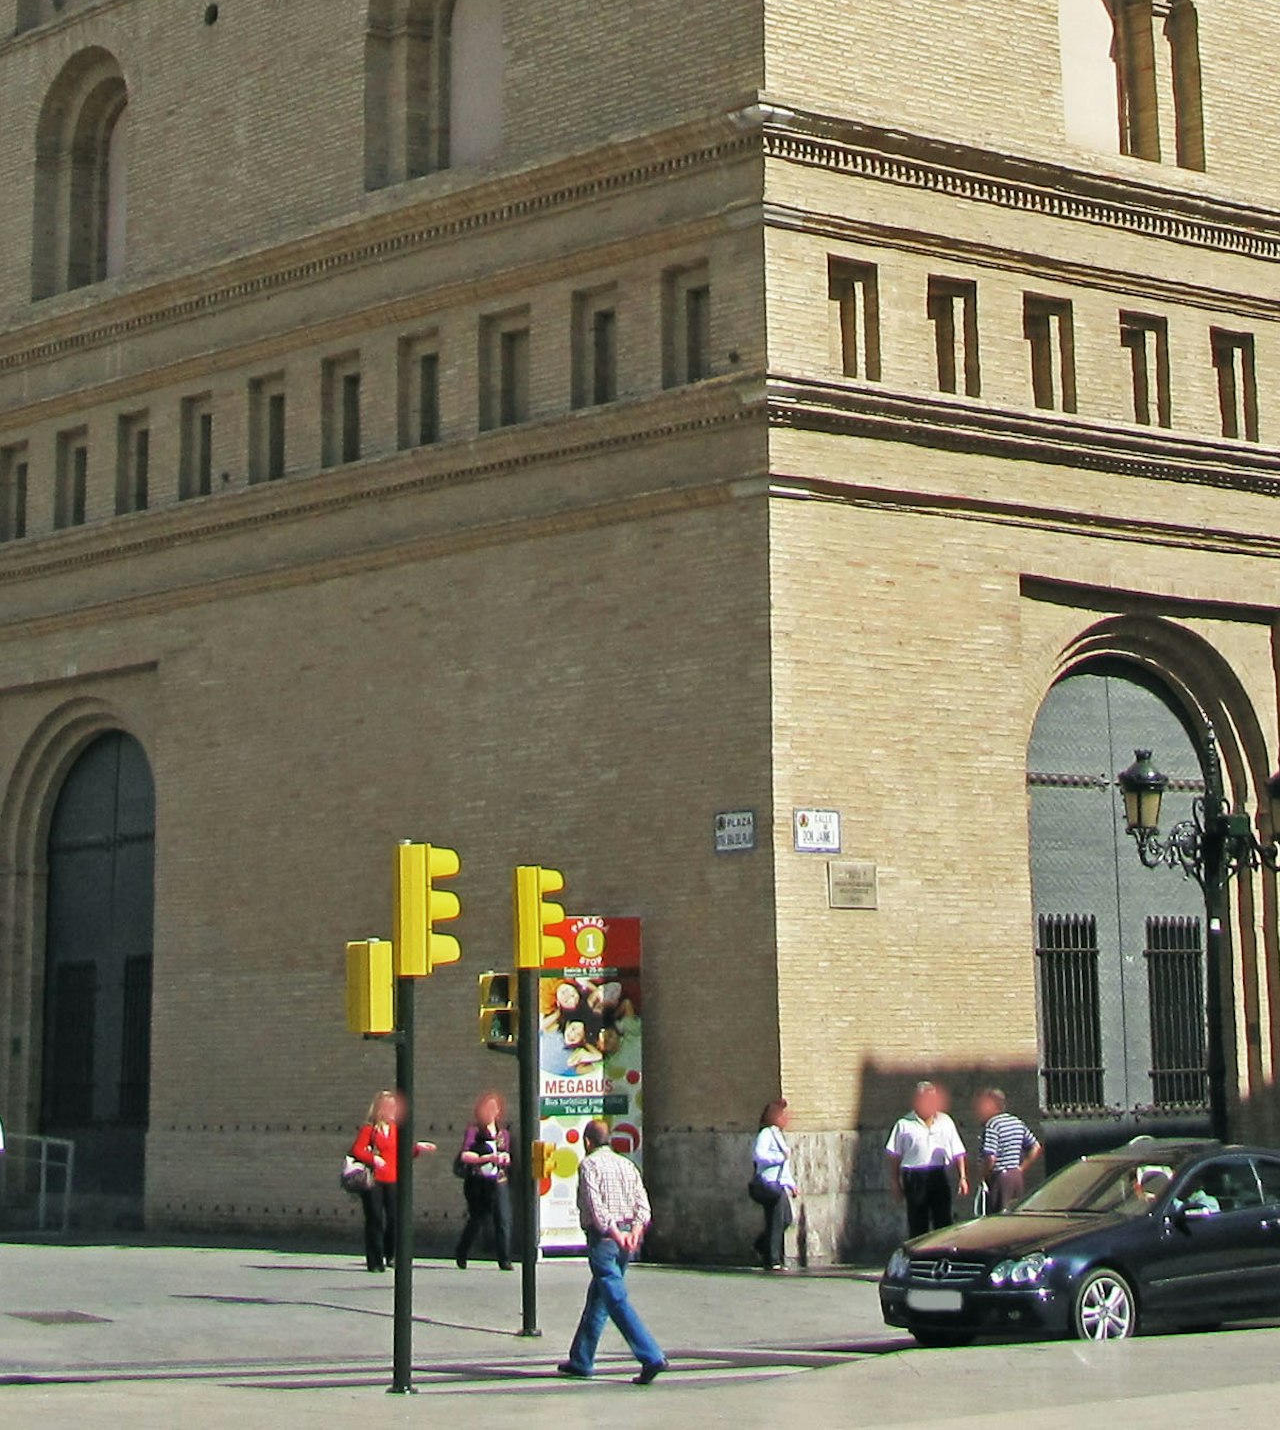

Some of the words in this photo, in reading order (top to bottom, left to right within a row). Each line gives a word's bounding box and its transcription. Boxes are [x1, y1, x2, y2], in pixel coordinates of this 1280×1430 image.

[727, 817, 751, 828] PLAZA
[815, 814, 832, 824] CALLE
[570, 917, 610, 933] PARADA
[585, 933, 596, 952] 1
[578, 956, 603, 966] STOP
[545, 1079, 613, 1094] MEGABUS
